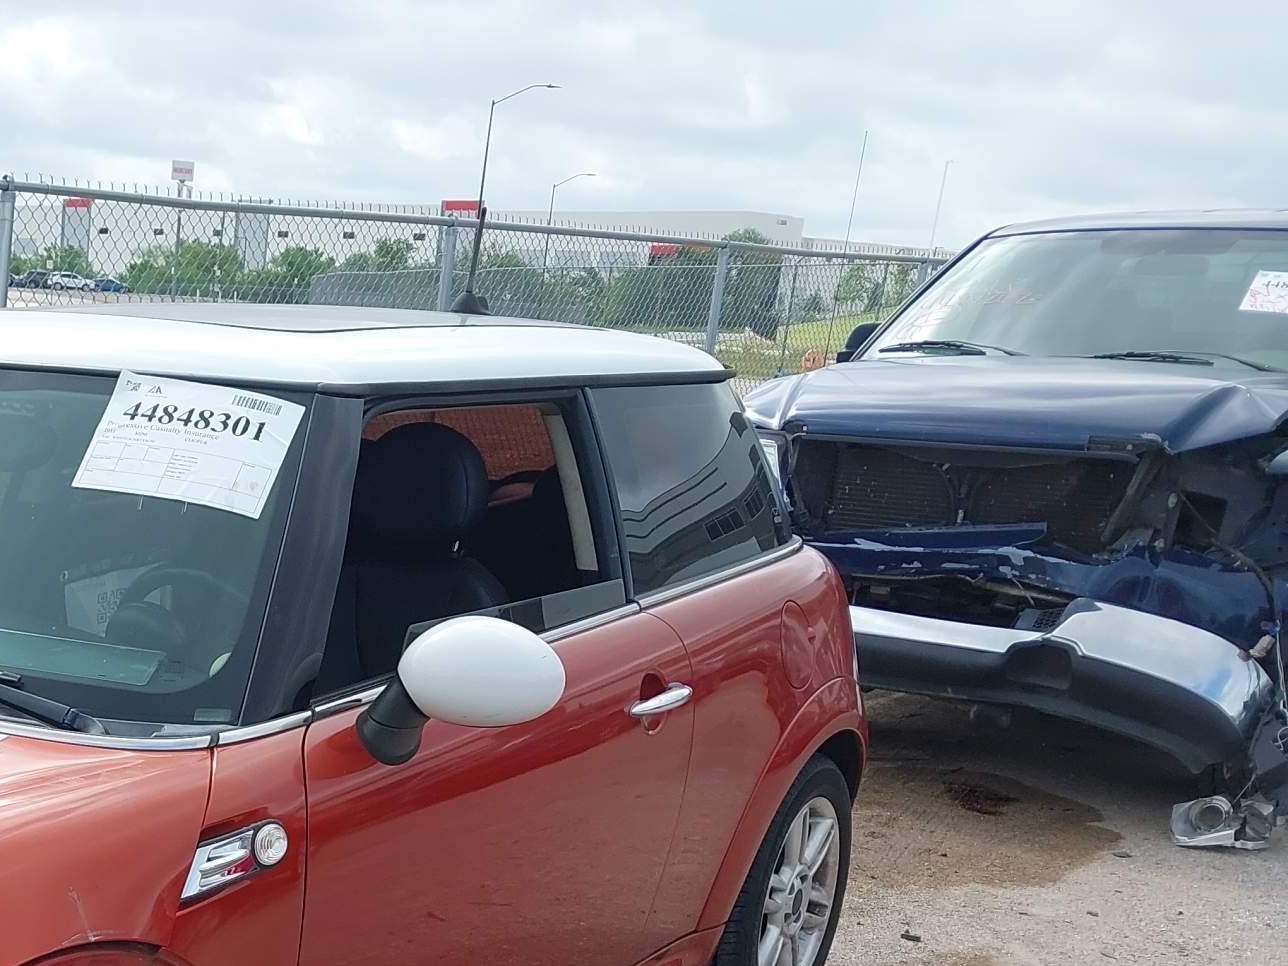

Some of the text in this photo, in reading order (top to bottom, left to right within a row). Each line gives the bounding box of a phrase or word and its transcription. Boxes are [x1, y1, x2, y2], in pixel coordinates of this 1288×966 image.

[123, 401, 266, 442] 44848301
[151, 424, 181, 436] Casualty
[184, 428, 220, 441] Insurance
